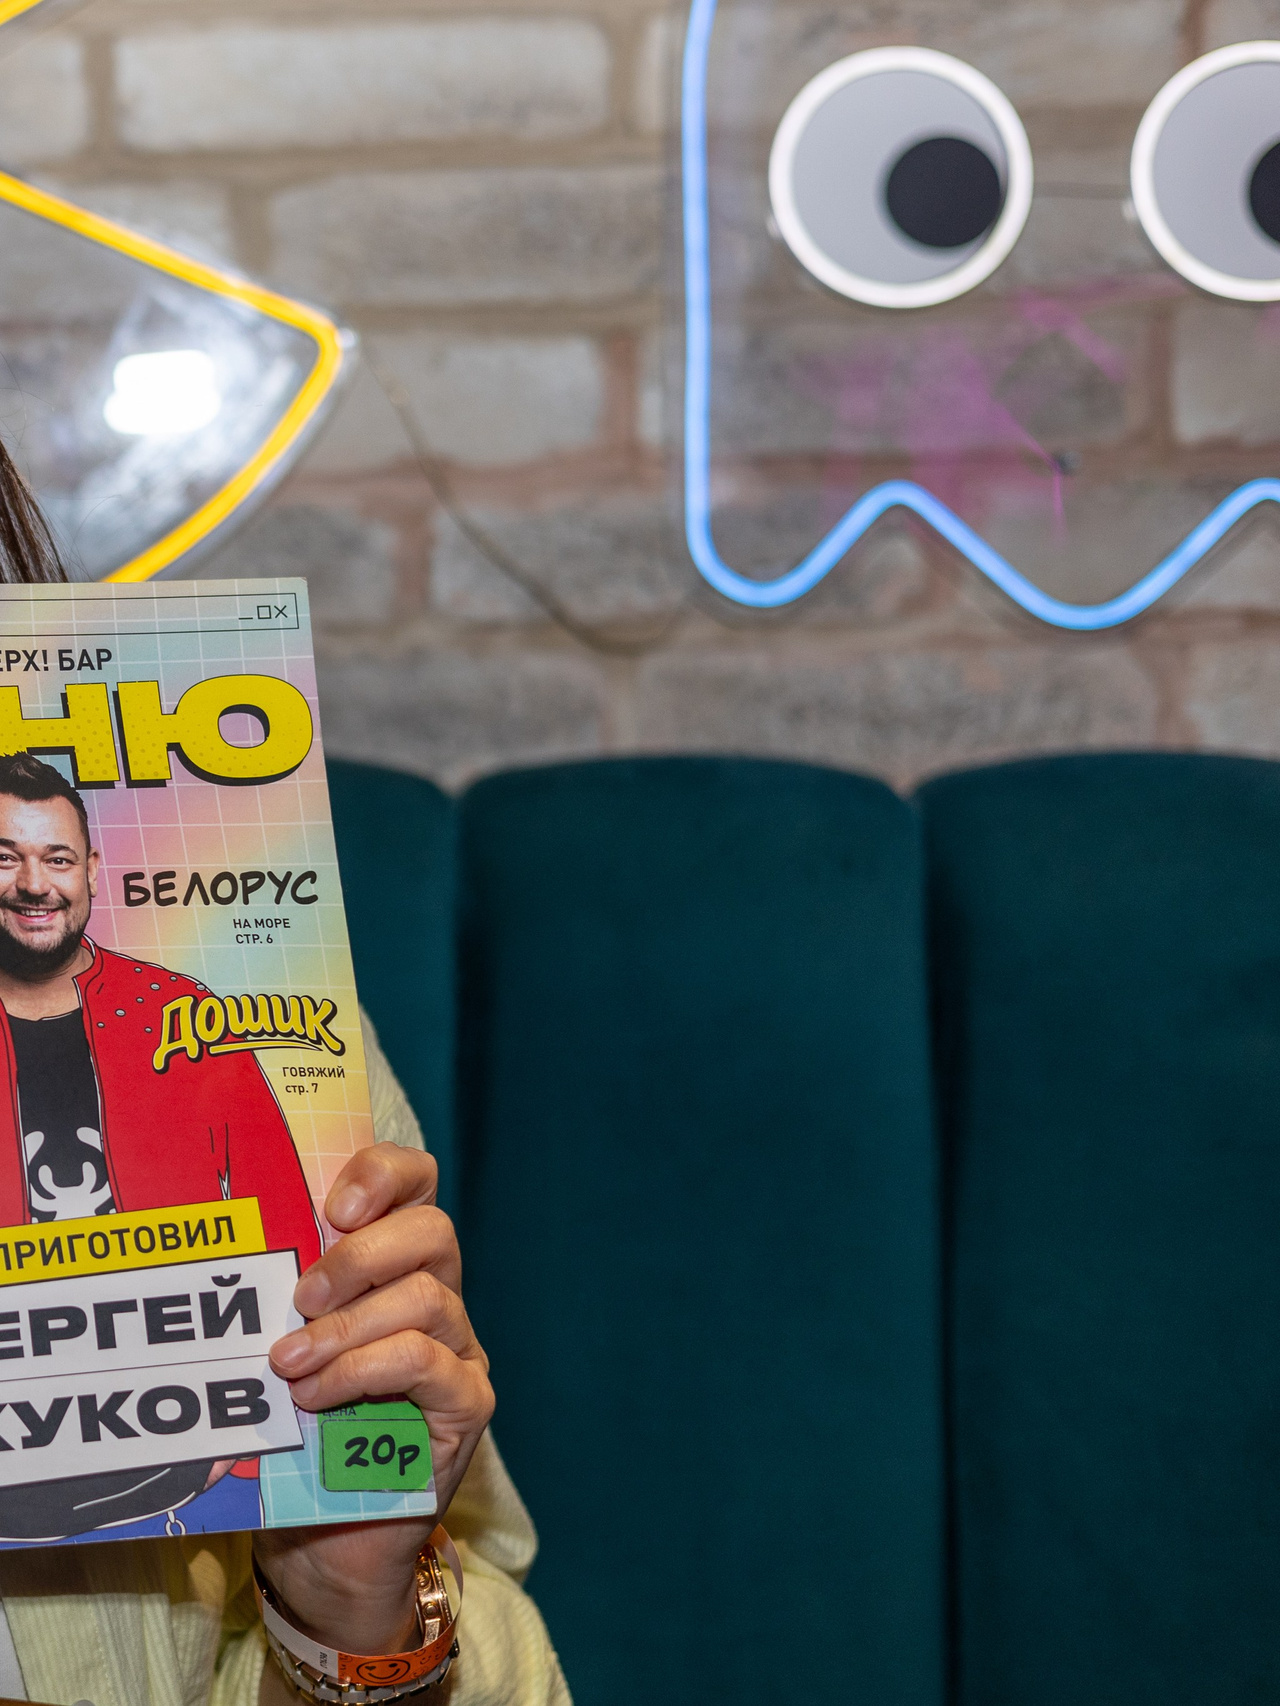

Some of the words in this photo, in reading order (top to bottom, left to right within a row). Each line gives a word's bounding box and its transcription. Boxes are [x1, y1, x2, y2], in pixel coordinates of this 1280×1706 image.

[58, 648, 113, 671] БАР
[123, 871, 319, 907] БЕЛОРУС
[233, 919, 251, 929] НА
[254, 918, 291, 929] МОРЕ
[235, 934, 263, 944] СТР.
[266, 934, 274, 944] 6
[282, 1065, 346, 1079] ГОВЯЖИЙ
[311, 1082, 319, 1093] 7
